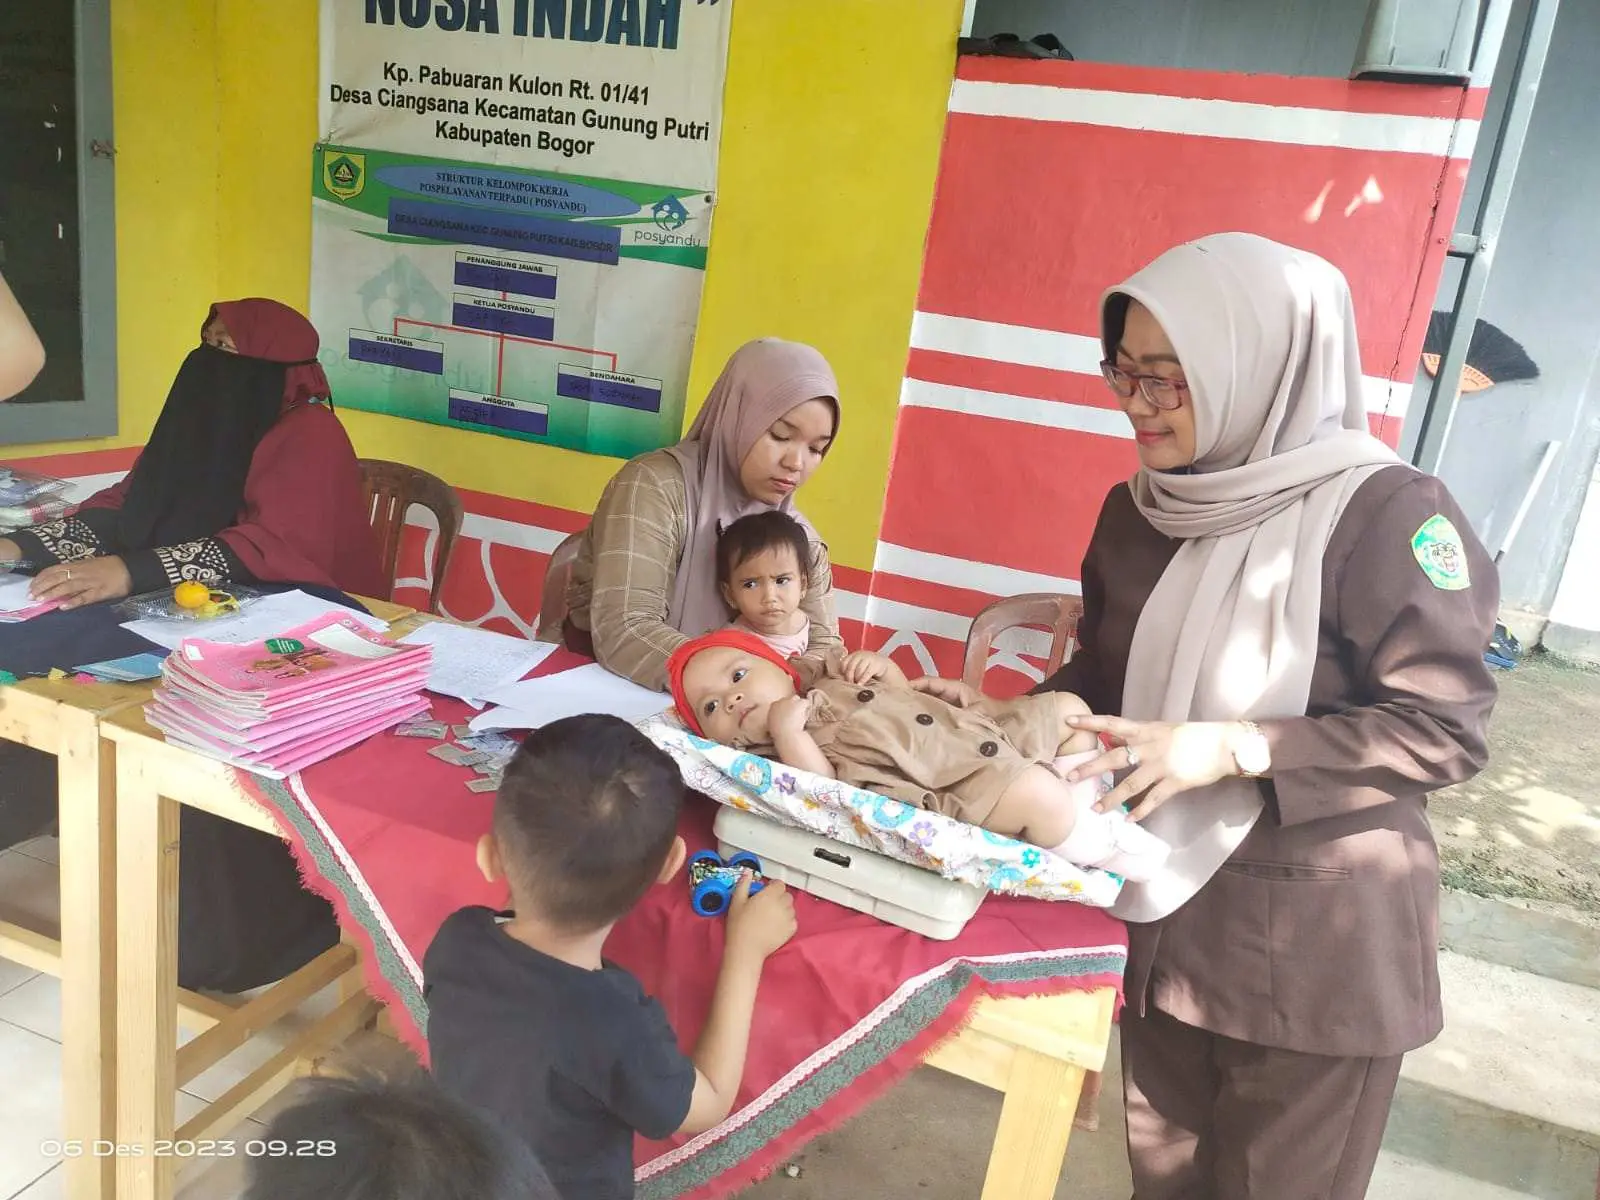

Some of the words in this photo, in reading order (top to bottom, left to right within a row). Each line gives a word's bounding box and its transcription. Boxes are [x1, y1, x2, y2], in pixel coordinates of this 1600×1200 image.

[384, 62, 413, 86] Kp.
[419, 65, 503, 91] Pabuaran
[509, 73, 563, 97] Kulon
[569, 79, 594, 101] Rt.
[601, 82, 649, 106] 01/41
[330, 84, 372, 105] Desa
[378, 88, 469, 114] Ciangsana
[475, 98, 576, 126] Kecamatan
[582, 109, 658, 140] Gunung
[664, 117, 710, 141] Putri
[436, 120, 531, 148] Kabupaten
[537, 131, 595, 157] Bogor
[436, 172, 484, 186] STRUKTUR
[486, 178, 540, 194] KELOMPOK
[540, 184, 569, 197] KERJA
[634, 230, 701, 247] posyandu
[466, 255, 517, 269] PENANGGUNG
[518, 264, 543, 273] JAWAB
[473, 299, 496, 308] KETUA
[497, 302, 535, 314] POSYANDU
[589, 371, 636, 384] BENDAHARA
